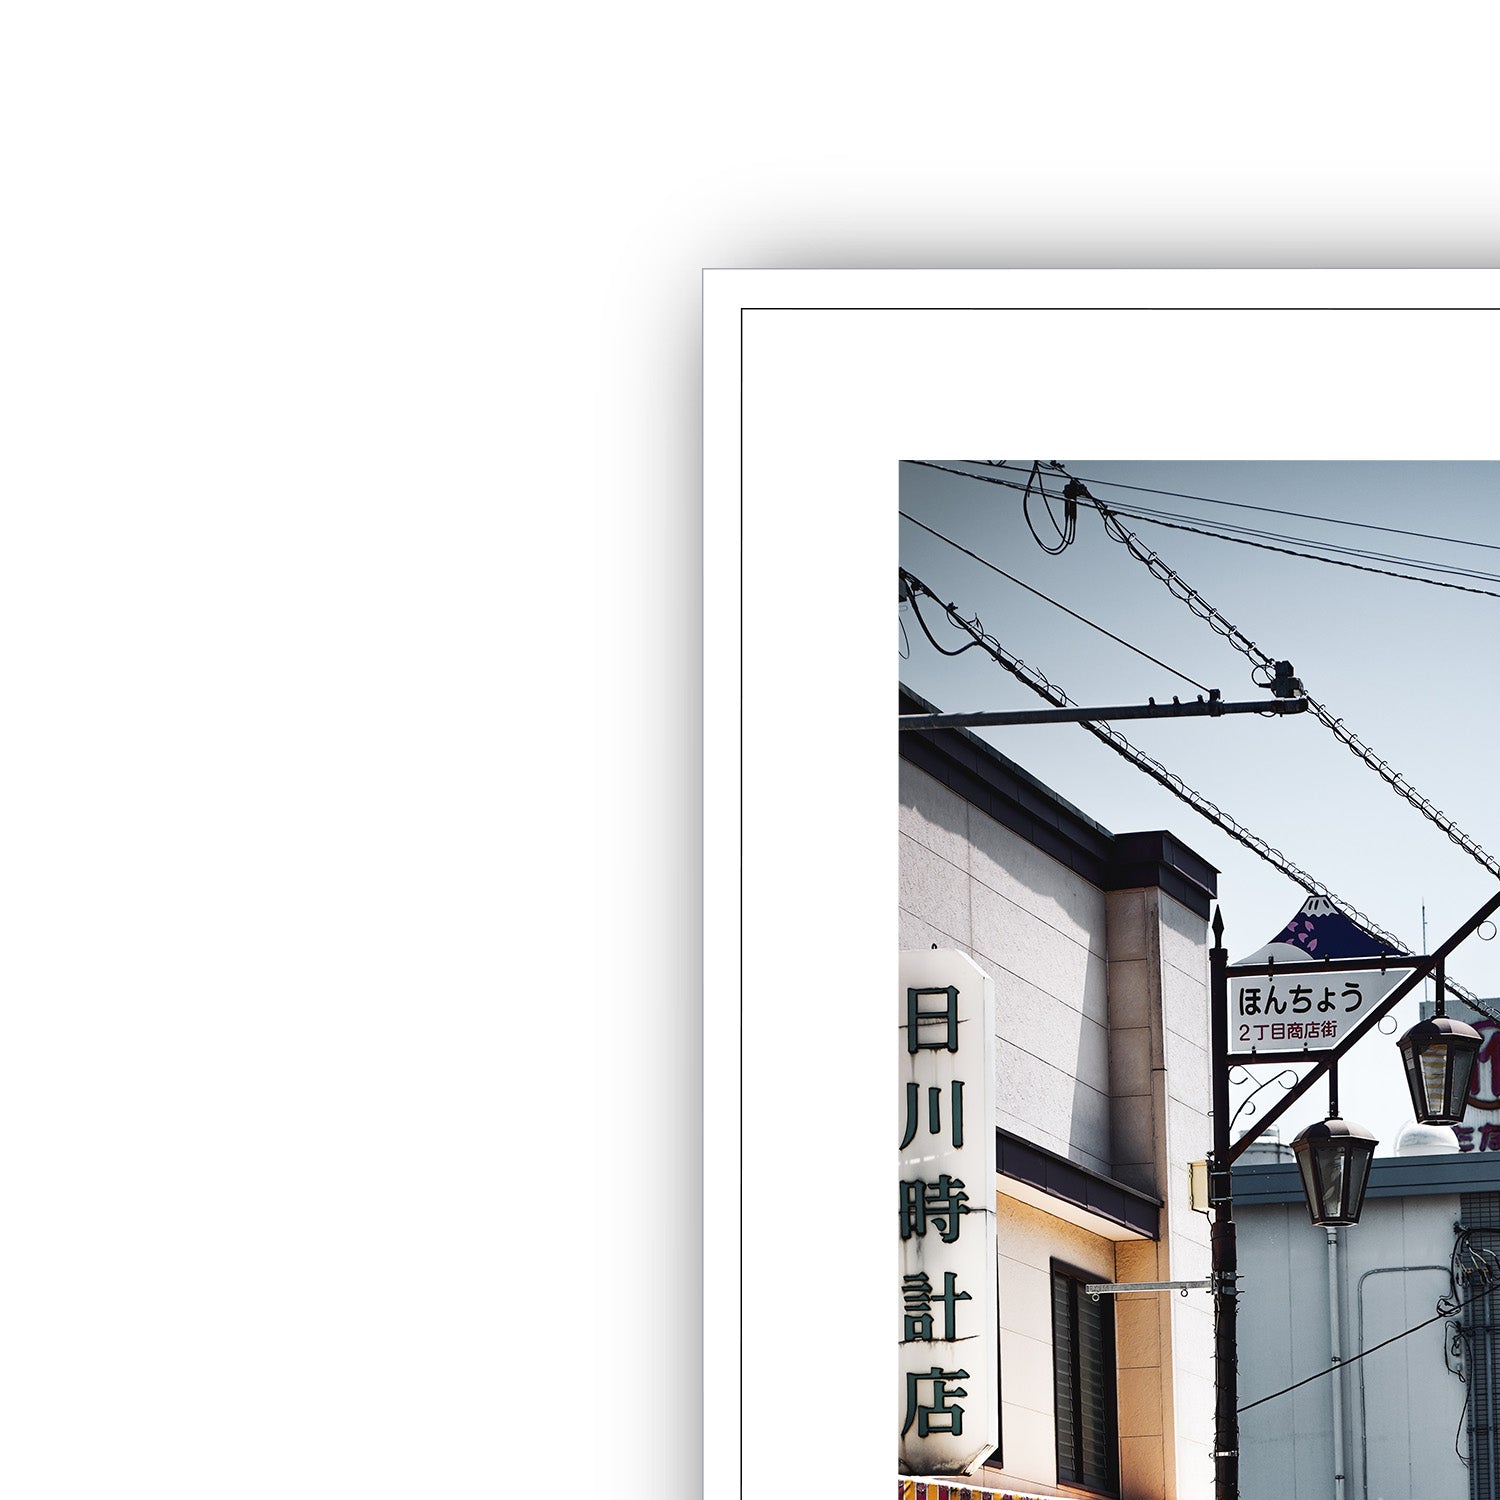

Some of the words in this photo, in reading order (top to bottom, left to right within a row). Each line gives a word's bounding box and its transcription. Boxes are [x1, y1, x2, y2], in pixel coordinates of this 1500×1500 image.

[1239, 982, 1363, 1016] ほんちょう
[1239, 1020, 1338, 1041] 2丁目商店街
[899, 985, 973, 1439] 日川時計店
